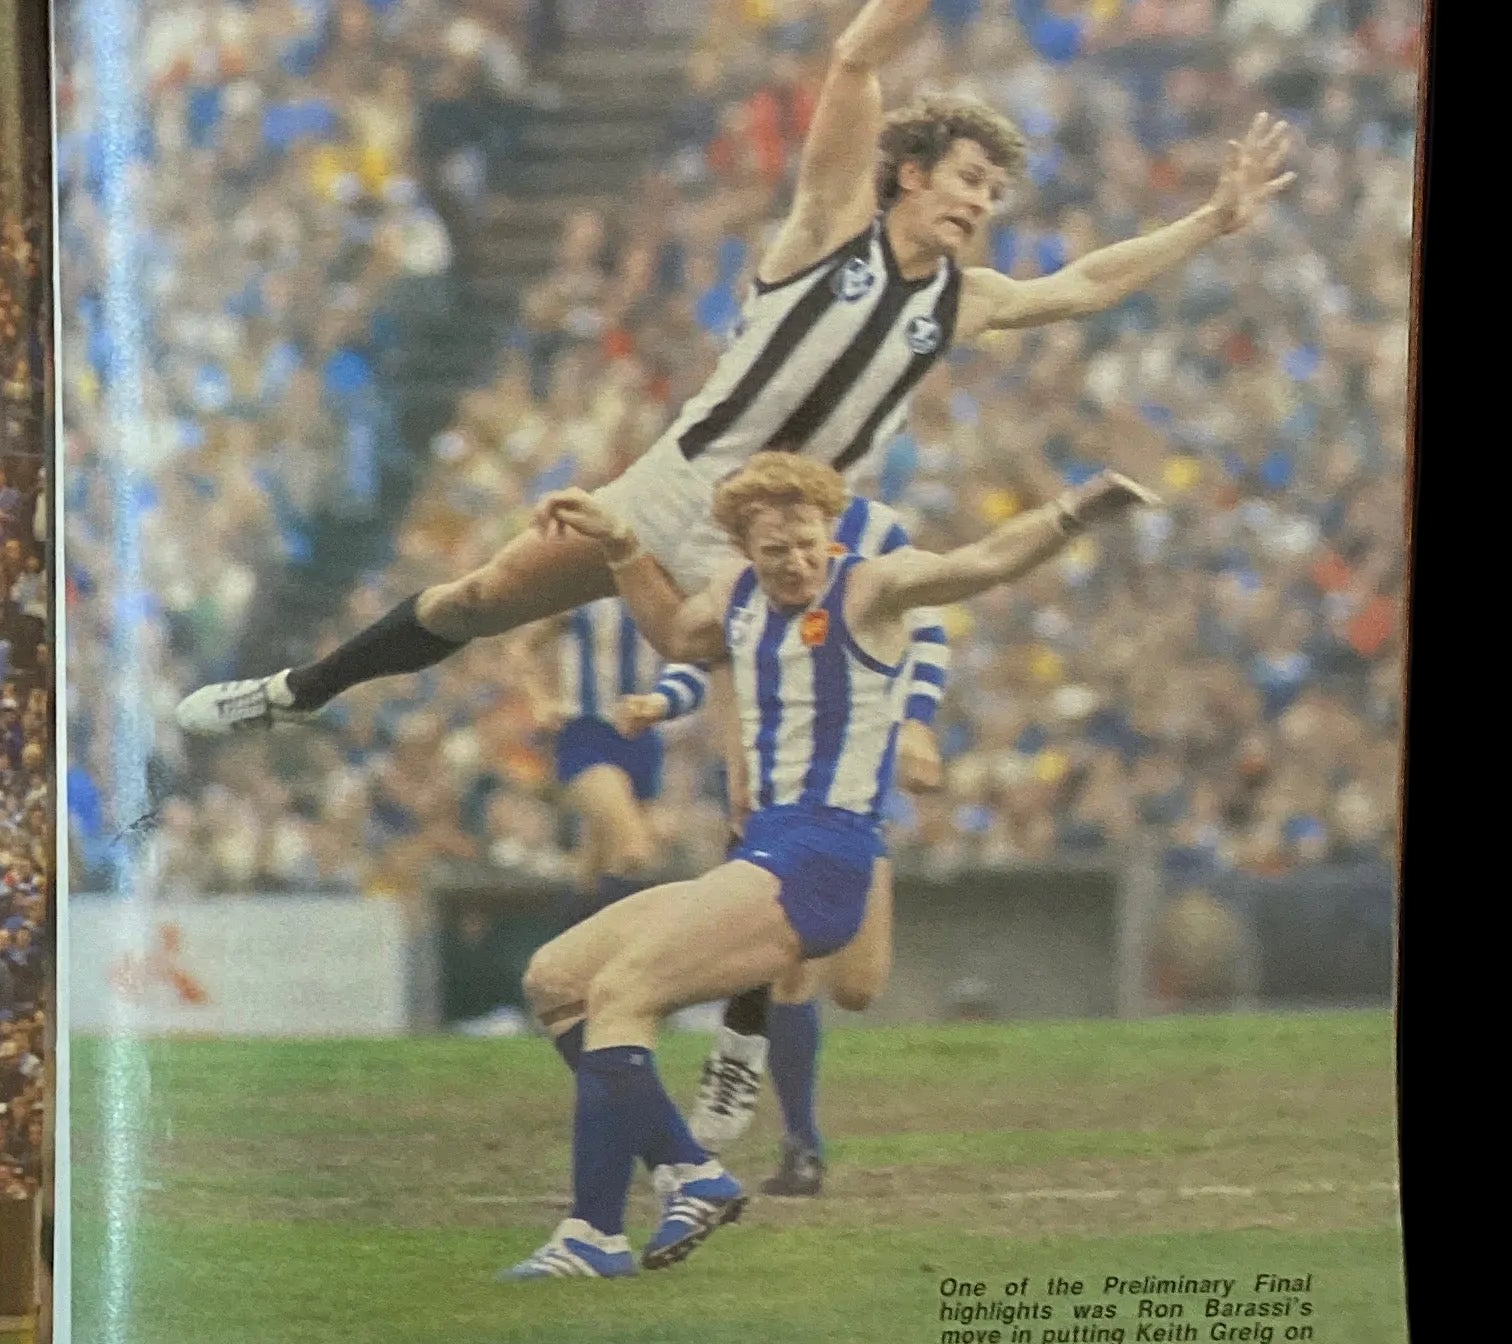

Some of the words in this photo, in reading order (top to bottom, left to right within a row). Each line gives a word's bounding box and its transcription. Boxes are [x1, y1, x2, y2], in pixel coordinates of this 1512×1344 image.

[940, 1277, 987, 1297] One
[1005, 1277, 1030, 1296] of
[1047, 1277, 1084, 1296] the
[1103, 1275, 1236, 1298] Preliminary
[1254, 1273, 1313, 1293] Final
[939, 1301, 1053, 1325] highlights
[1073, 1303, 1117, 1319] was
[1138, 1299, 1184, 1318] Ron
[1205, 1297, 1313, 1318] Barassi's
[941, 1329, 1002, 1344] move
[1011, 1325, 1032, 1344] in
[1136, 1322, 1198, 1342] Keith
[1210, 1321, 1274, 1344] Greig
[1284, 1325, 1314, 1341] on
